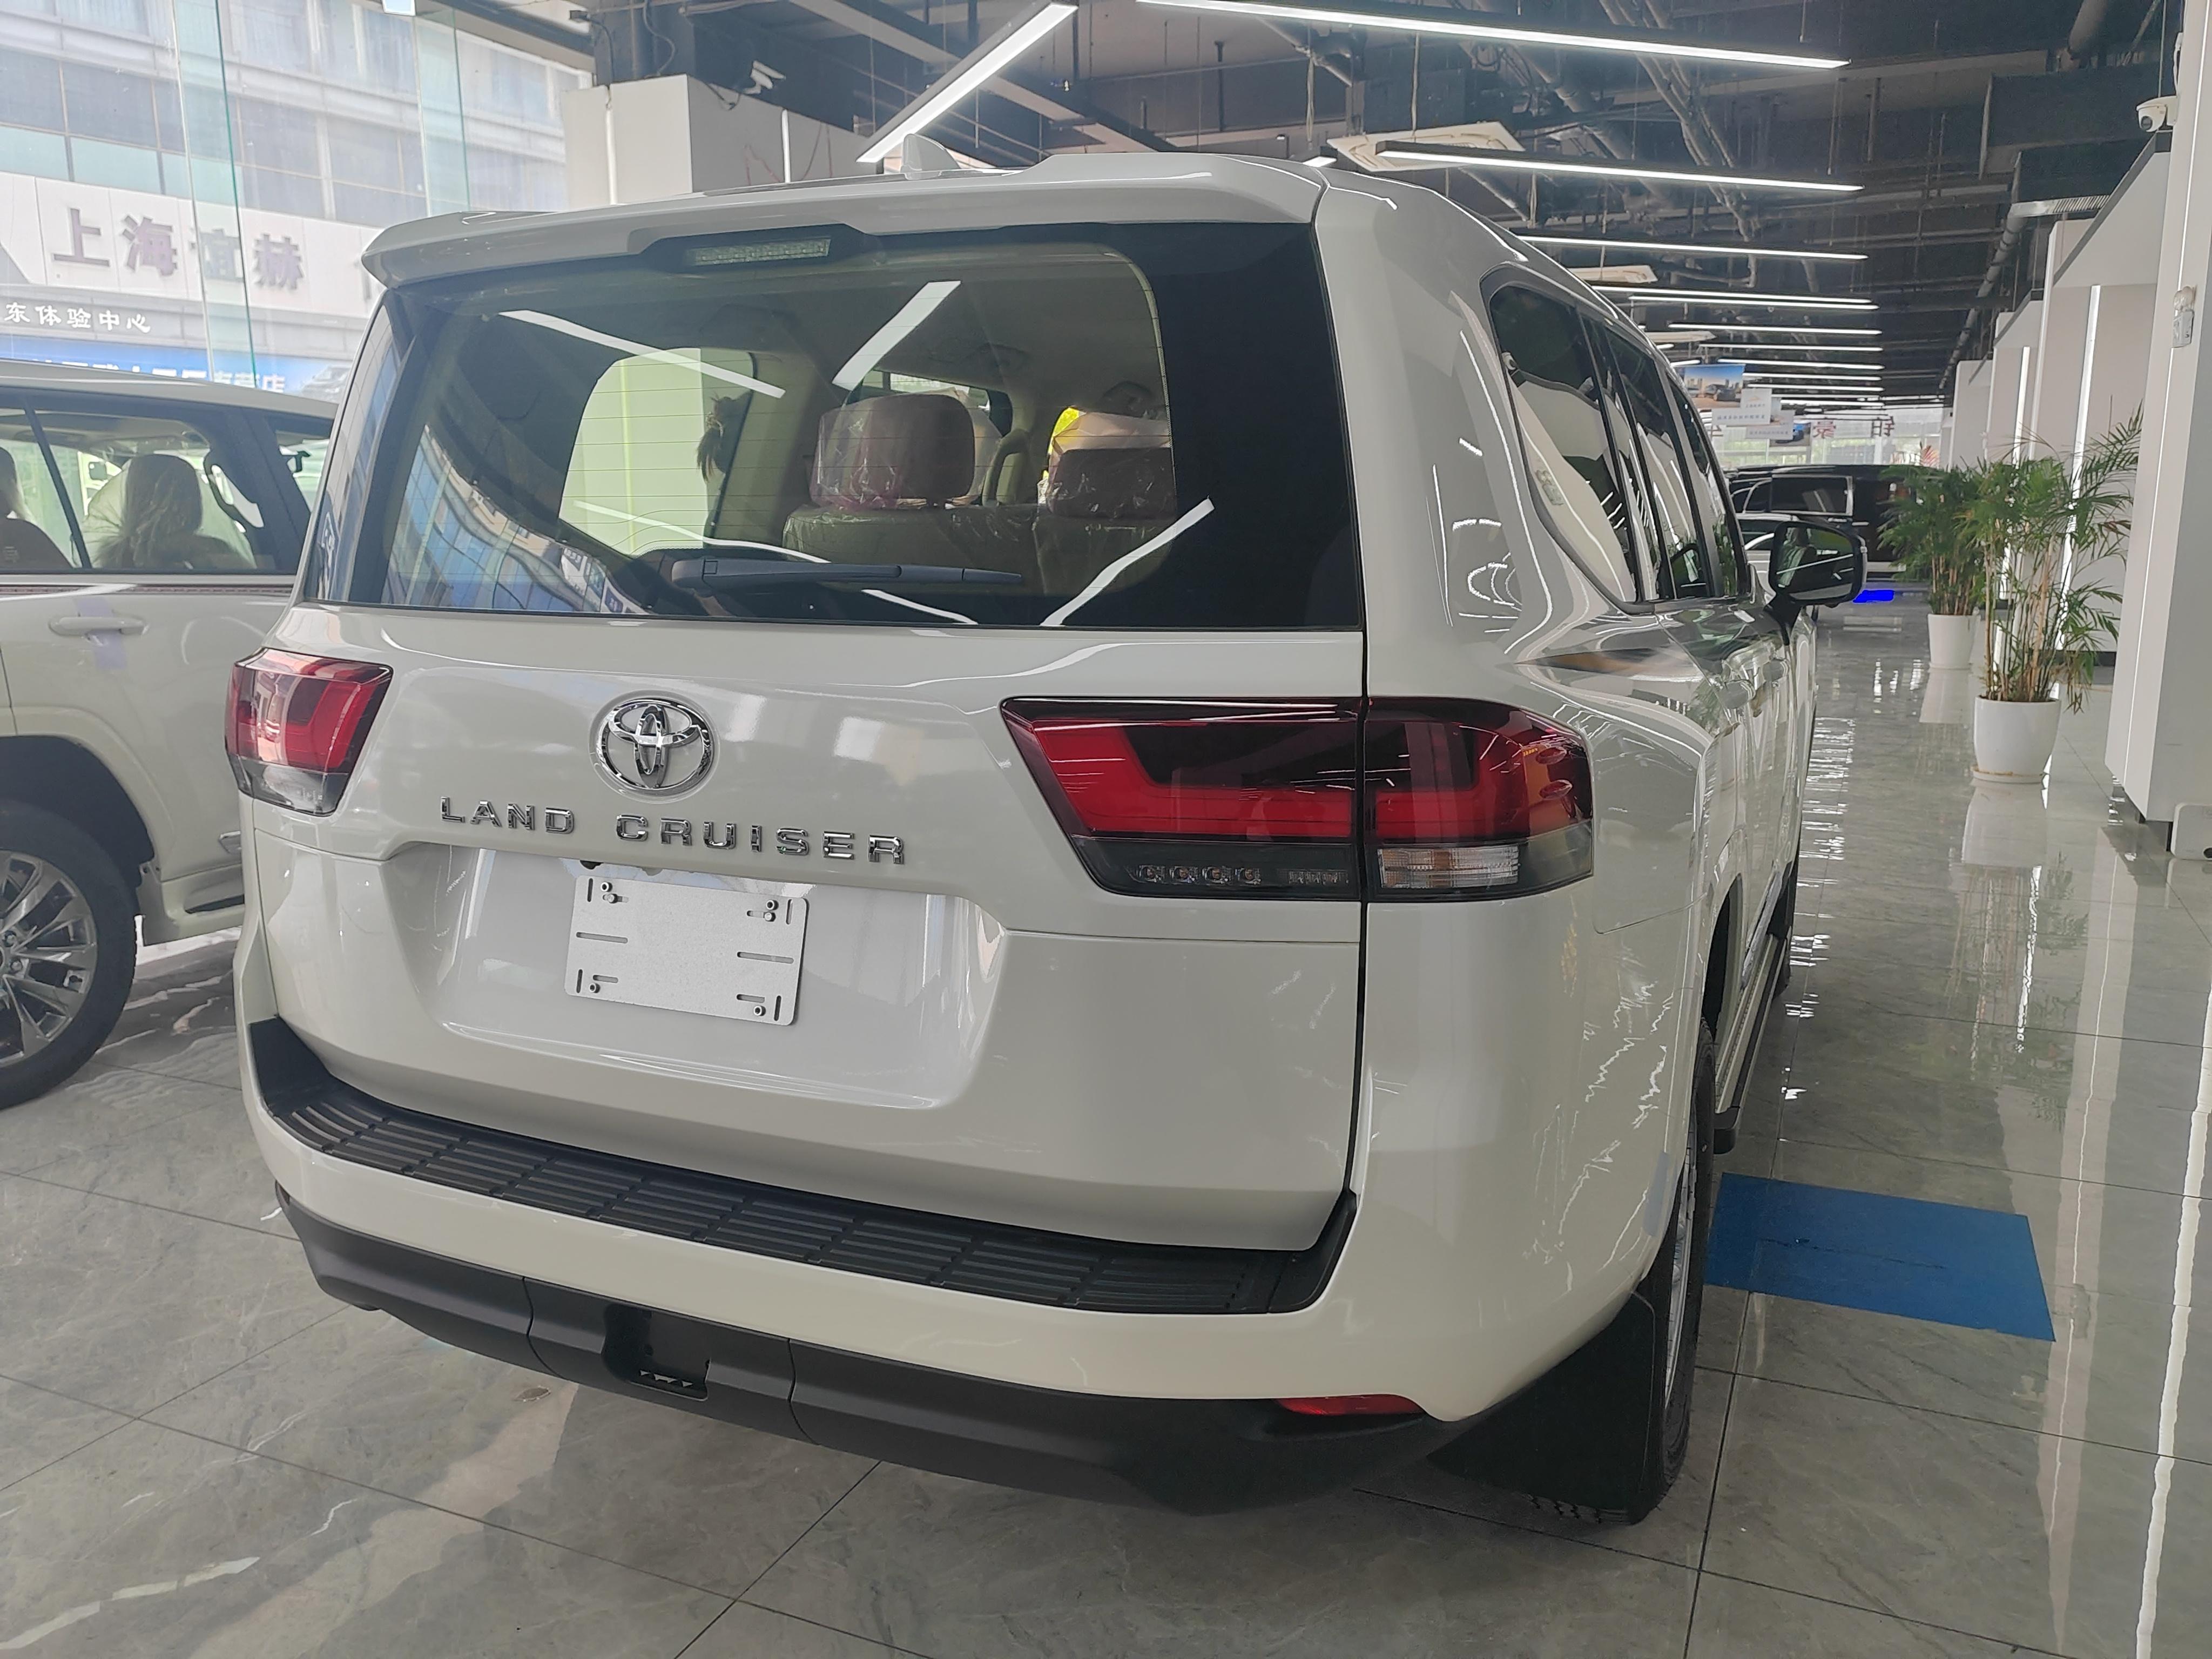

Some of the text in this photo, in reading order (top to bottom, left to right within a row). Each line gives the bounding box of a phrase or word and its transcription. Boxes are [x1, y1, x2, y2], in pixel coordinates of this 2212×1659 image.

[4, 302, 151, 333] 东体验中心
[440, 796, 904, 864] LAND CRUISER
